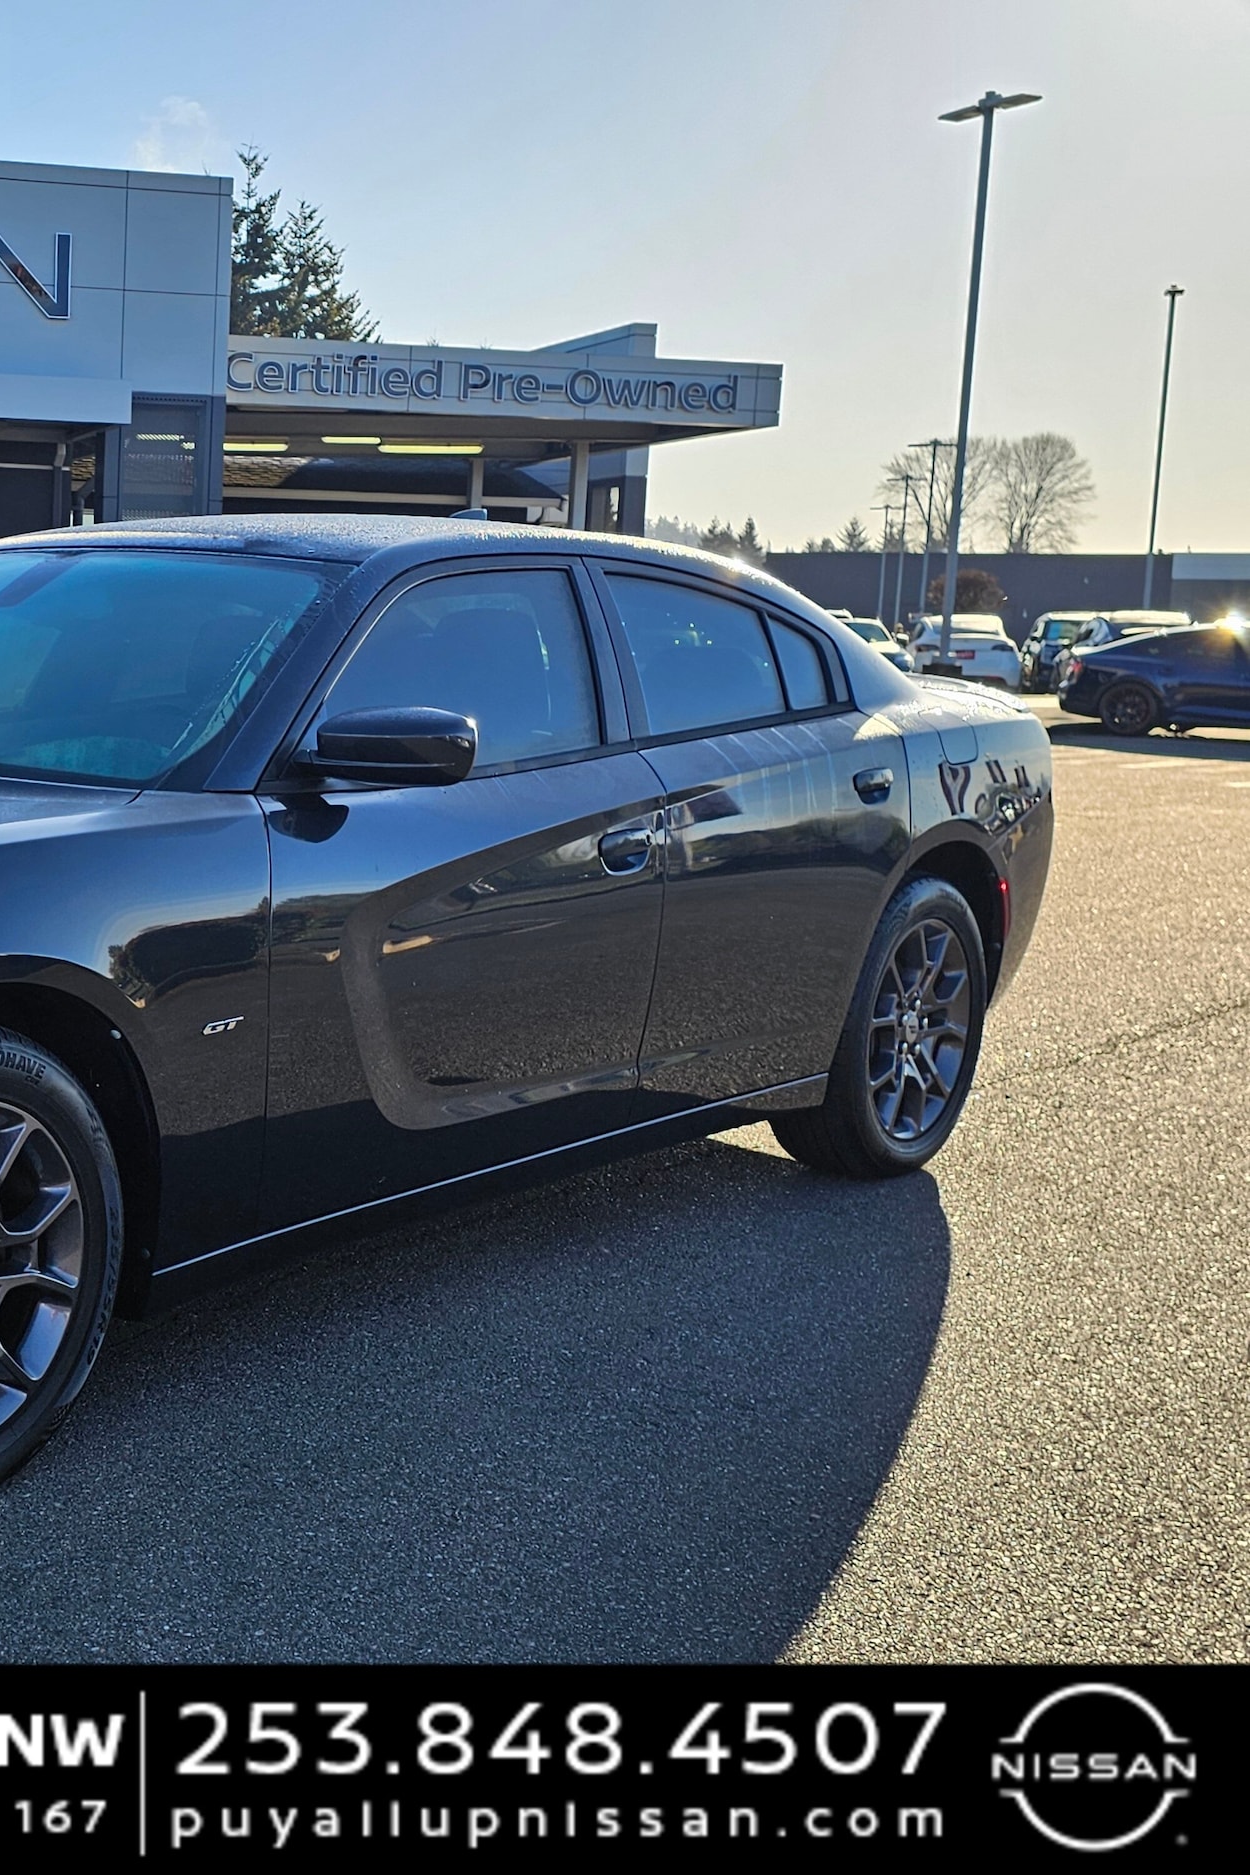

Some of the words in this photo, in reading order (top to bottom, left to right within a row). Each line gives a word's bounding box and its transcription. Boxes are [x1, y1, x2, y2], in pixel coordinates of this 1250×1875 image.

[226, 351, 444, 400] Certified
[459, 361, 740, 414] Pre-Owned
[203, 1016, 244, 1035] GT
